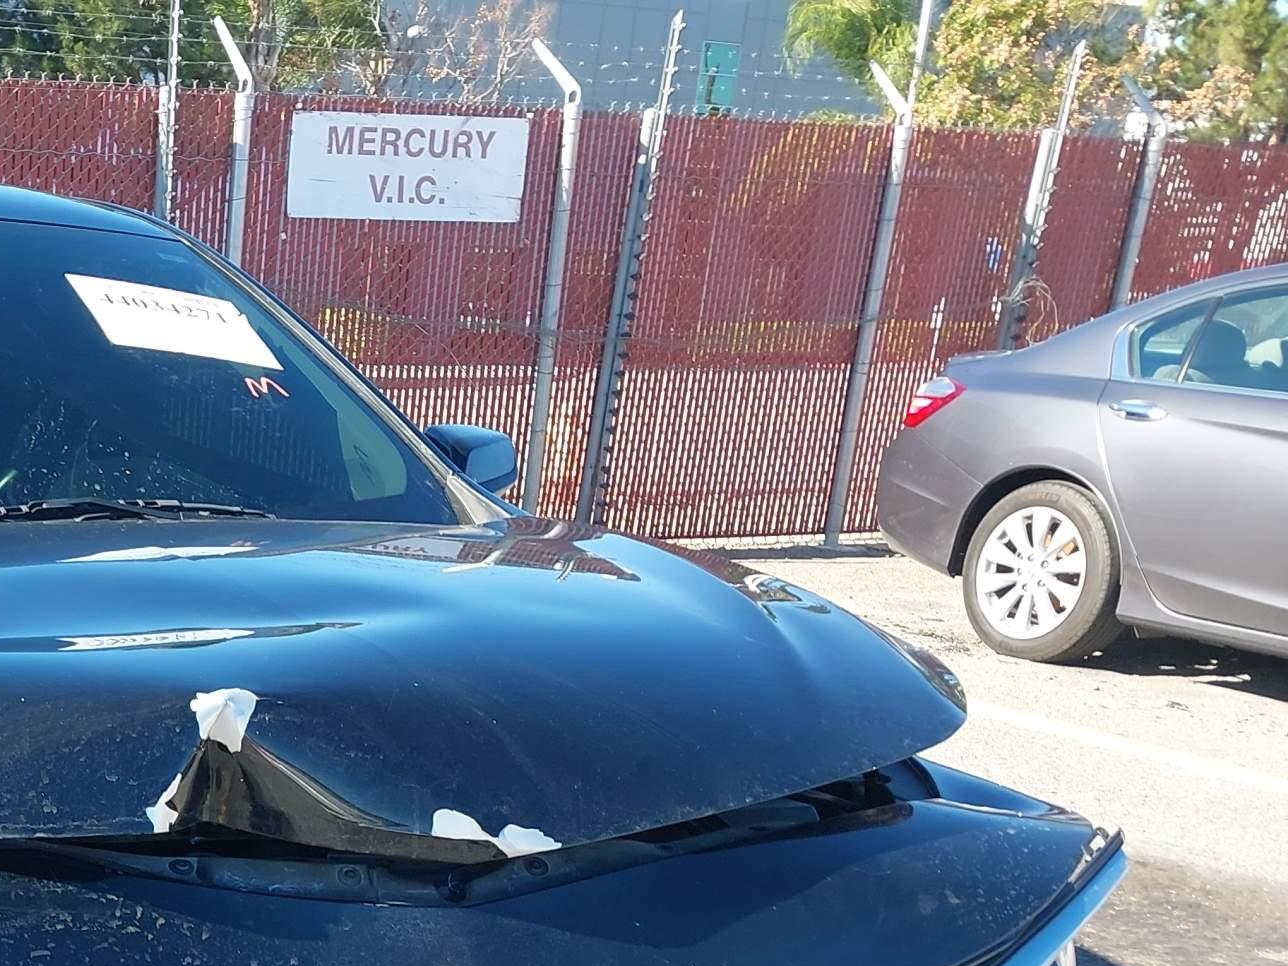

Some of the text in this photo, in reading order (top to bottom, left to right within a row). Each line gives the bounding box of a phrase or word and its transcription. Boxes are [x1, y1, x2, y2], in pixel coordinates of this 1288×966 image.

[326, 125, 497, 160] MERCURY
[368, 174, 446, 205] V.I.C.
[243, 375, 291, 399] M
